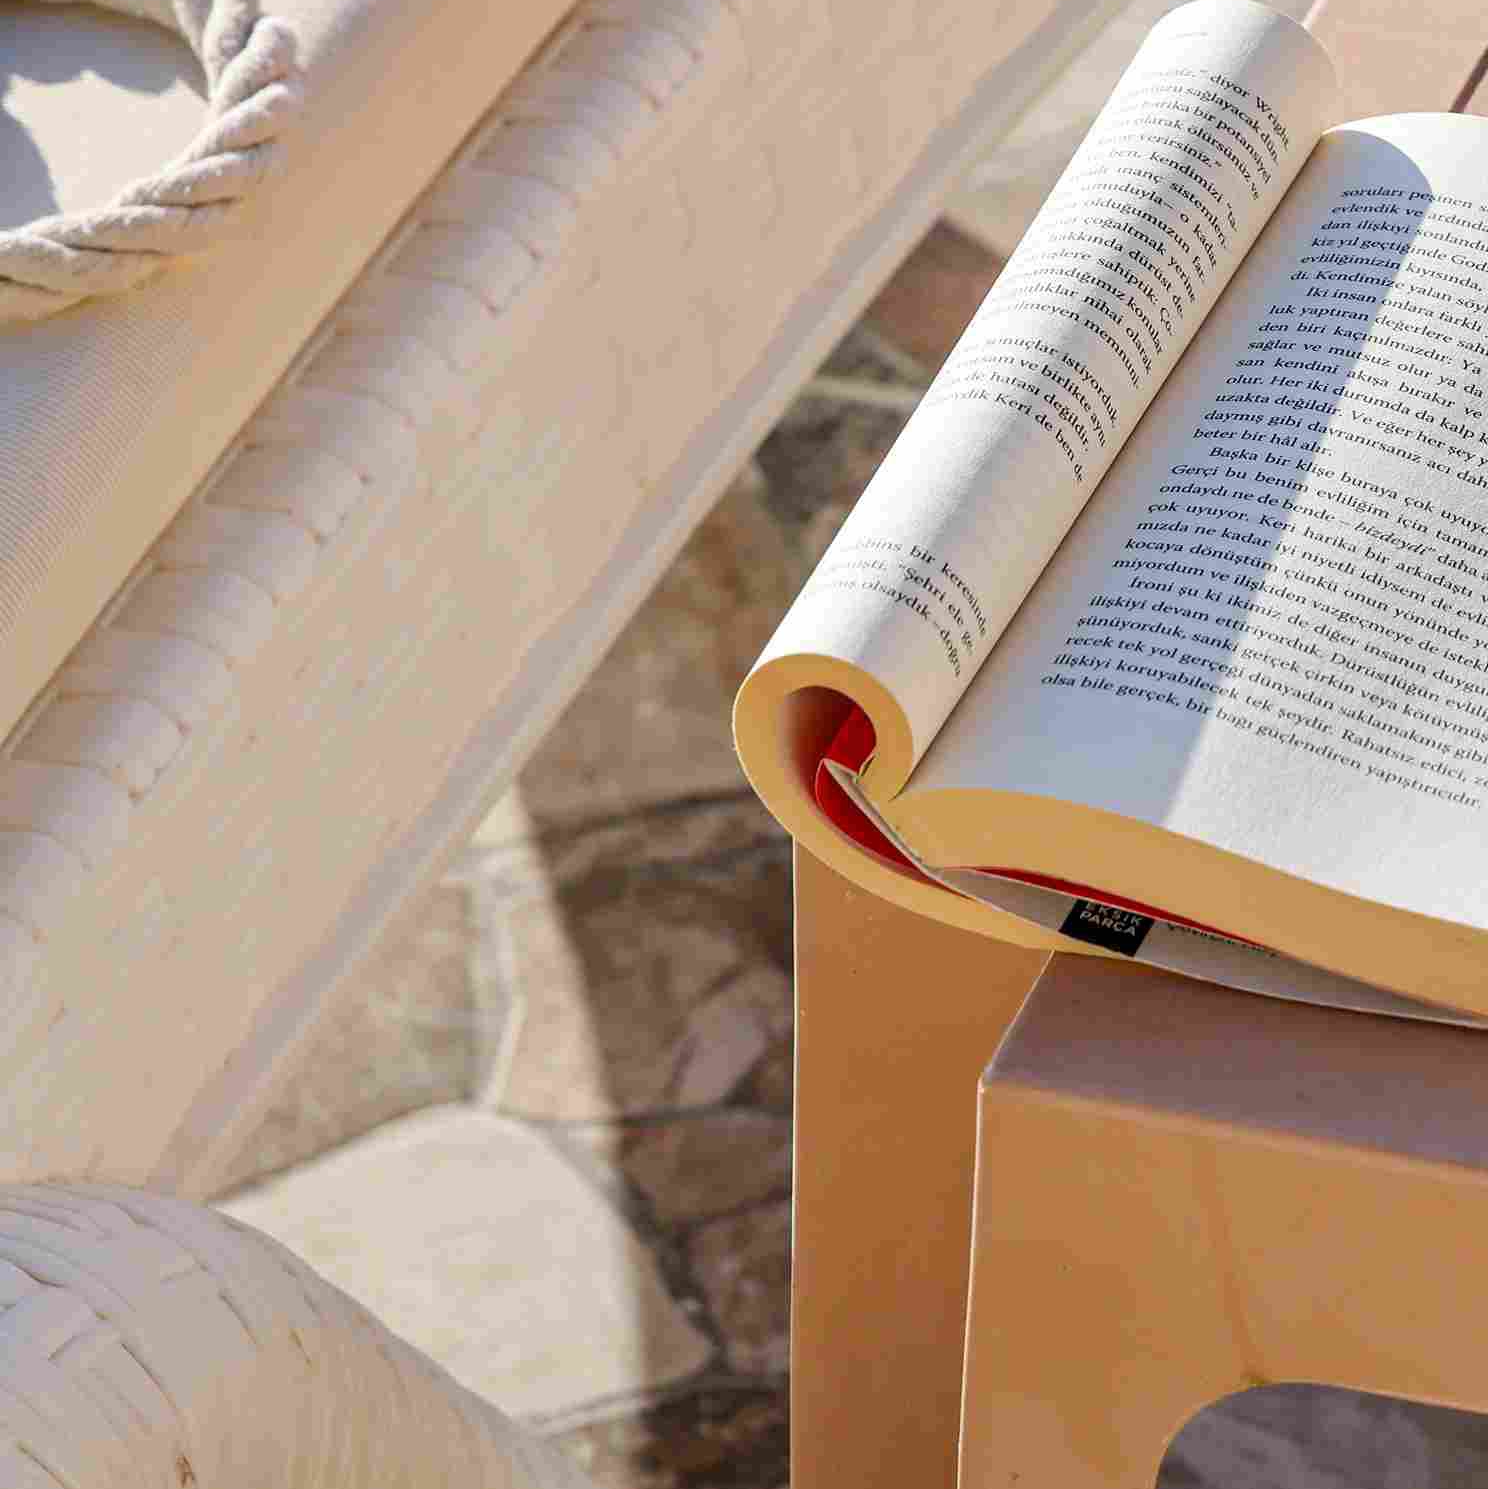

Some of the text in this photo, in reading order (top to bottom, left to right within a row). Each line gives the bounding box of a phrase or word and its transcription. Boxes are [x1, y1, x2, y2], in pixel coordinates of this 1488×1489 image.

[1210, 73, 1250, 98] diyor
[1340, 186, 1405, 197] soruları
[1329, 203, 1402, 214] evlendik
[1402, 208, 1425, 218] ve
[1298, 253, 1402, 270] evliliğimizin
[1313, 269, 1405, 289] Kendimize
[1405, 284, 1453, 302] yalan
[1256, 322, 1291, 332] den
[1294, 321, 1329, 334] biri
[1458, 358, 1484, 376] Ya
[994, 392, 1033, 416] Keri
[1223, 374, 1263, 385] olur.
[1268, 375, 1304, 388] Her
[1304, 379, 1331, 393] iki
[1330, 384, 1411, 415] durumda
[1412, 407, 1436, 424] da
[1438, 416, 1476, 442] kalp
[1208, 446, 1266, 462] Başka
[1262, 451, 1292, 467] bir
[1294, 458, 1336, 479] klişe
[1338, 470, 1399, 499] buraya
[1400, 495, 1438, 514] çok
[1223, 466, 1255, 480] bu
[1252, 470, 1310, 493] benim
[1395, 512, 1436, 537] için
[910, 545, 936, 564] bir
[1123, 537, 1185, 554] kocaya
[1186, 542, 1279, 573] dönüştüm
[1341, 588, 1389, 612] onun
[1390, 607, 1470, 643] yönünde
